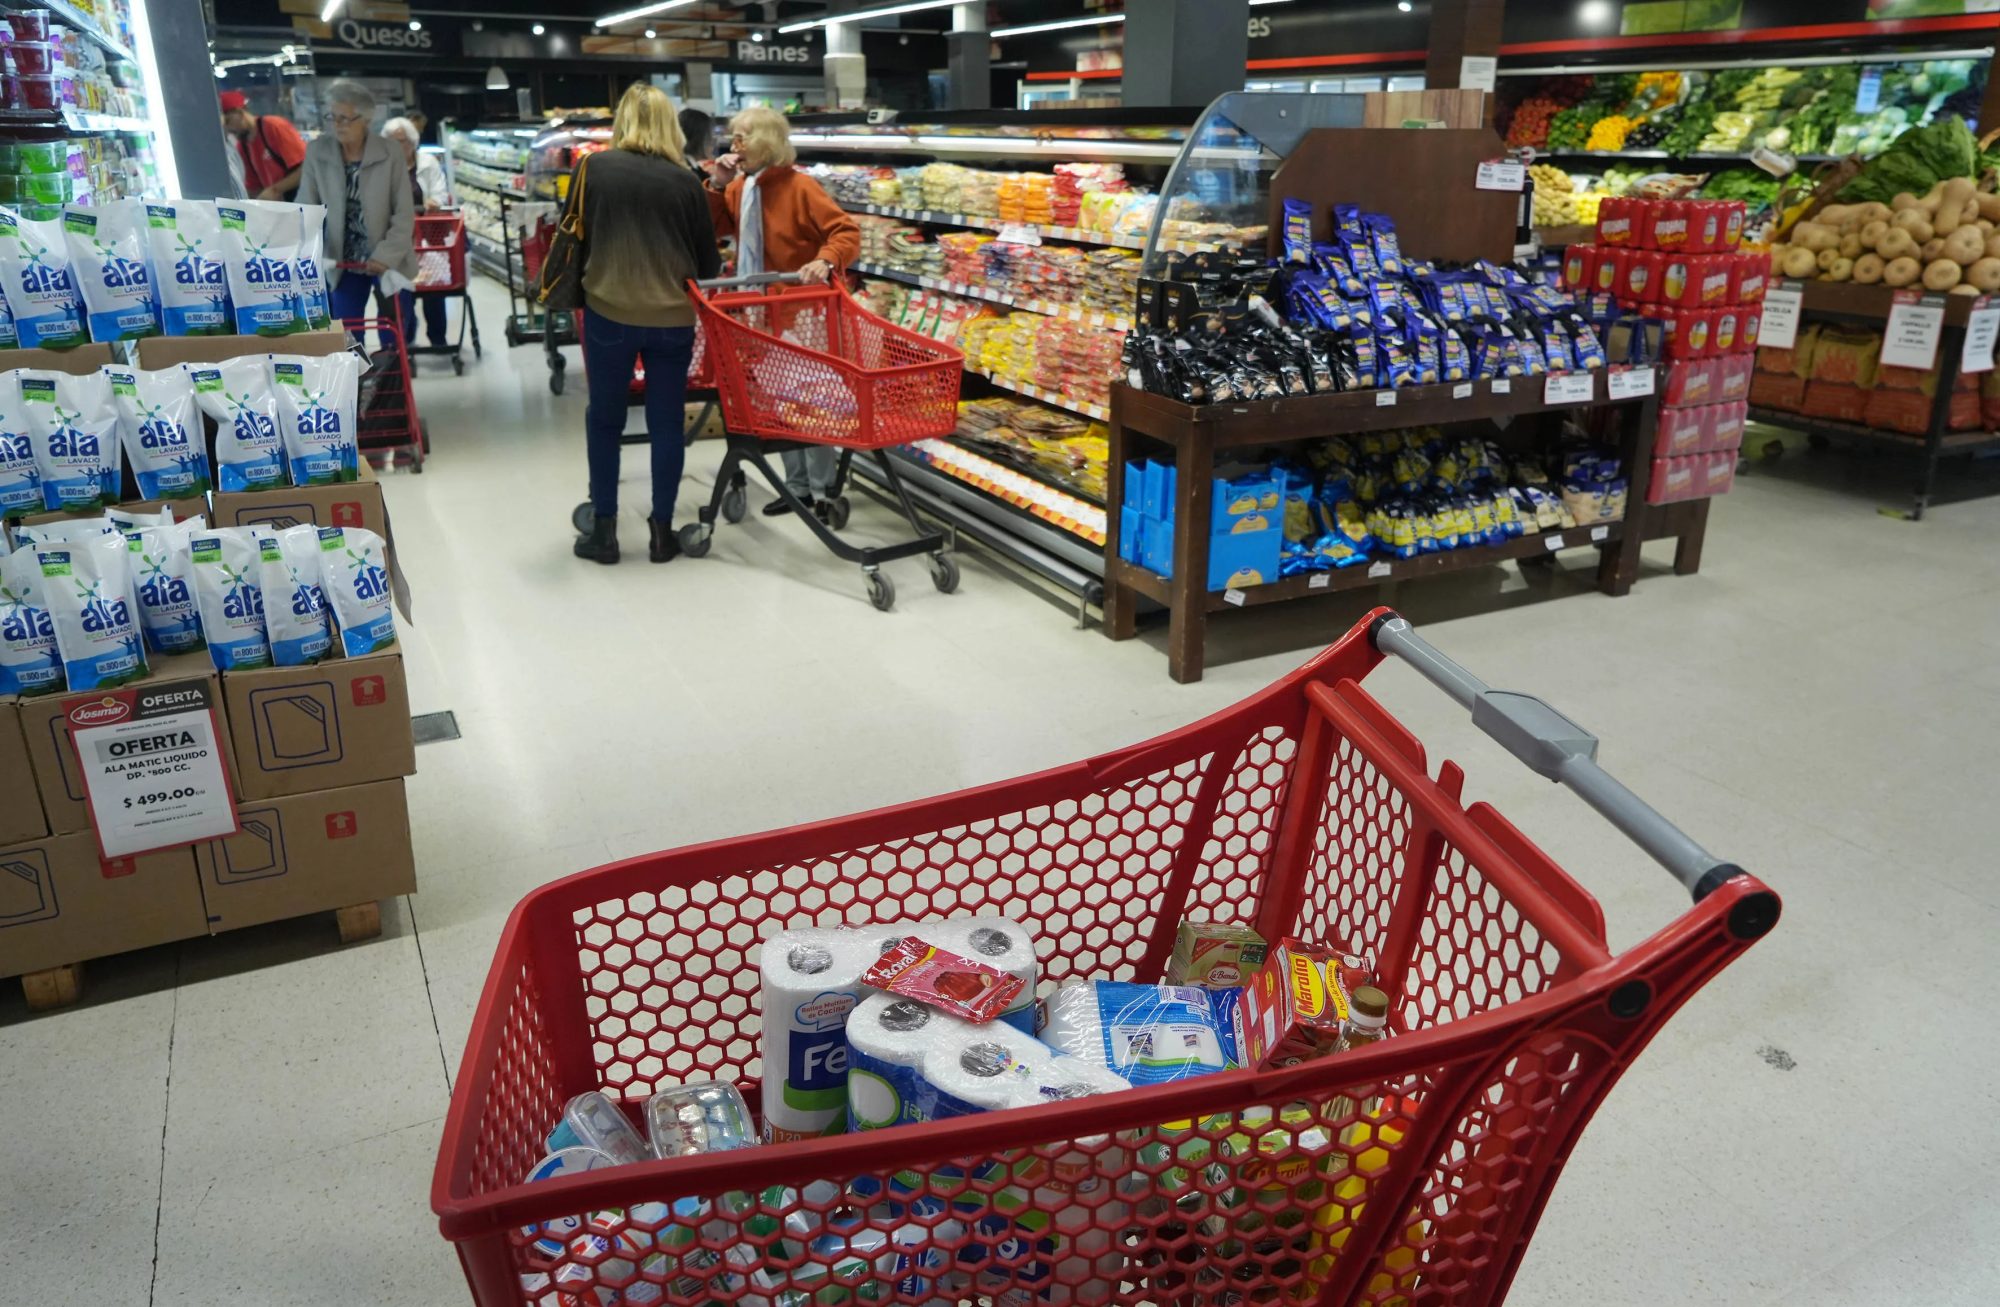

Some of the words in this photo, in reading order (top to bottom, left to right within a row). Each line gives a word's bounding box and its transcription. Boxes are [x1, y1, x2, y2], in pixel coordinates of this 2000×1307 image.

[339, 20, 432, 48] Quesos
[1247, 17, 1270, 37] es
[737, 41, 809, 62] Panes
[21, 265, 72, 293] ala
[102, 258, 148, 287] ala
[175, 257, 222, 284] ala
[245, 258, 291, 283] ala
[297, 258, 318, 281] la
[301, 279, 320, 287] AVADO
[139, 421, 188, 449] ala
[235, 411, 276, 441] ala
[297, 409, 341, 435] ala
[0, 434, 34, 463] la
[48, 430, 99, 457] ala
[313, 433, 342, 441] LAVADO
[140, 576, 190, 607] ala
[353, 567, 388, 600] ala
[161, 602, 193, 613] LAVADO
[224, 585, 264, 620] ala
[292, 584, 326, 617] ala
[2, 607, 54, 641] ala
[81, 599, 130, 633] ala
[105, 624, 133, 637] LAVADO
[142, 689, 204, 708] OFERTA
[76, 705, 124, 721] Josimar
[109, 731, 196, 757] OFERTA
[104, 765, 127, 774] ALA
[129, 757, 161, 770] MATIC
[163, 750, 208, 764] LIQUIDO
[127, 769, 146, 780] DP.
[174, 764, 191, 772] CC.
[123, 797, 133, 809] $
[137, 787, 195, 806] 499.00
[1209, 970, 1218, 982] La
[1217, 970, 1239, 981] Banda
[1295, 958, 1315, 1014] Marolio
[817, 1005, 847, 1017] Cocina
